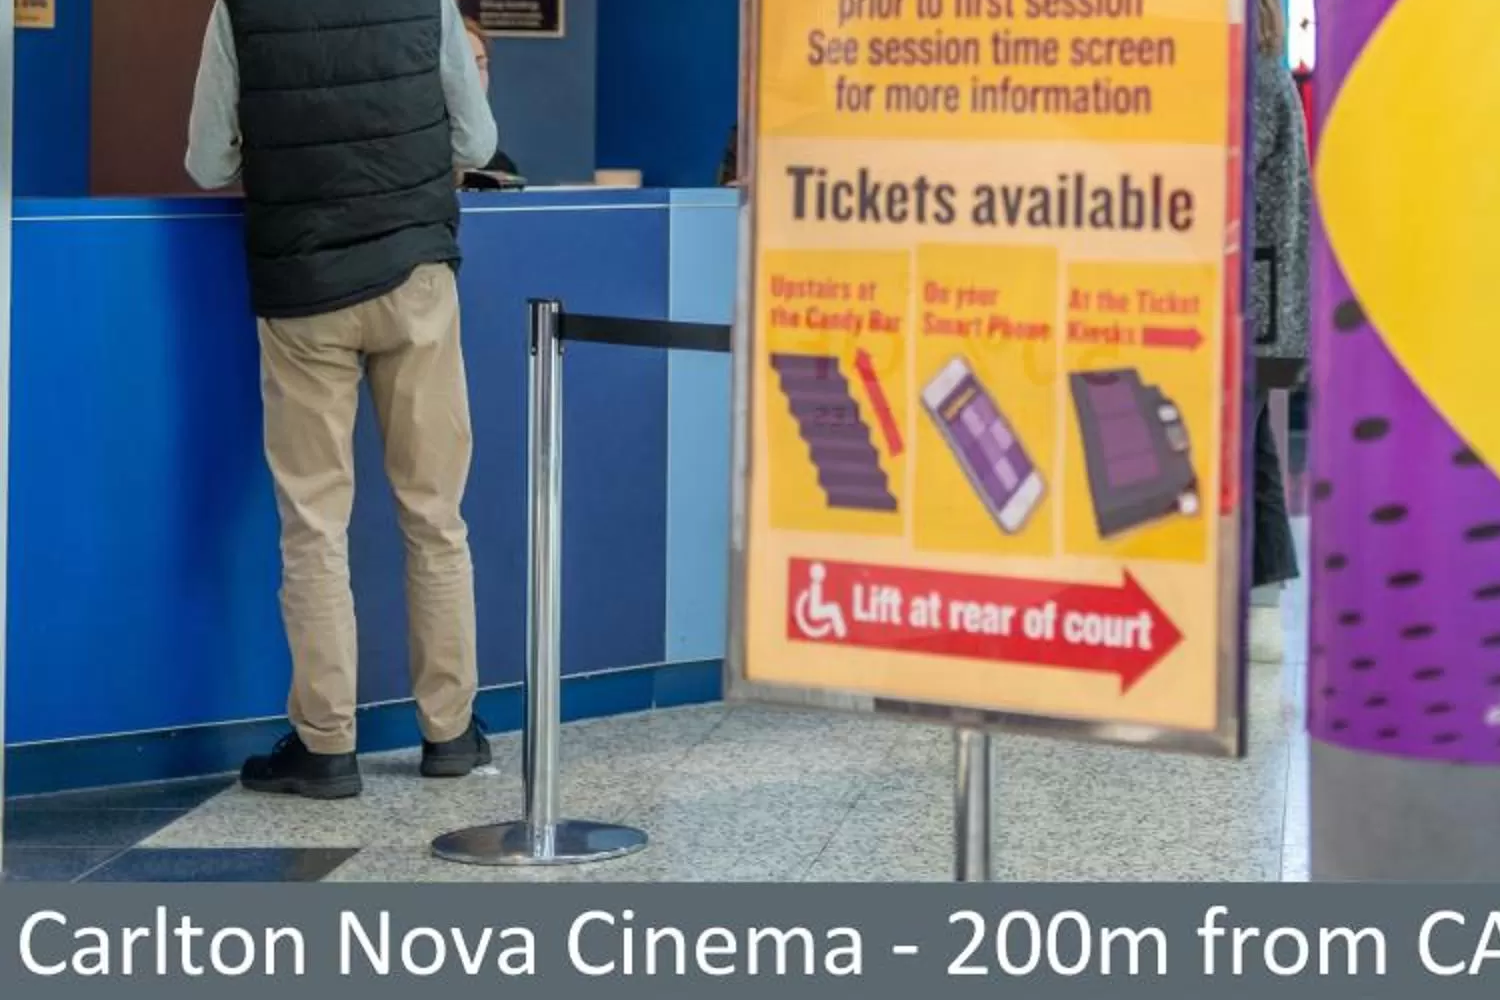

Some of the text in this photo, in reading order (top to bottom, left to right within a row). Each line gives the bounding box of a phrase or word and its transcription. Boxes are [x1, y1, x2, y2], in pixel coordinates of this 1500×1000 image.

[807, 30, 1176, 67] See session time screen
[835, 75, 1152, 115] for more information
[786, 164, 1196, 233] Tickets available
[806, 305, 862, 335] Candy
[1136, 288, 1200, 315] Ticket
[922, 311, 983, 337] Smart
[853, 583, 1153, 650] Lift at rear of court
